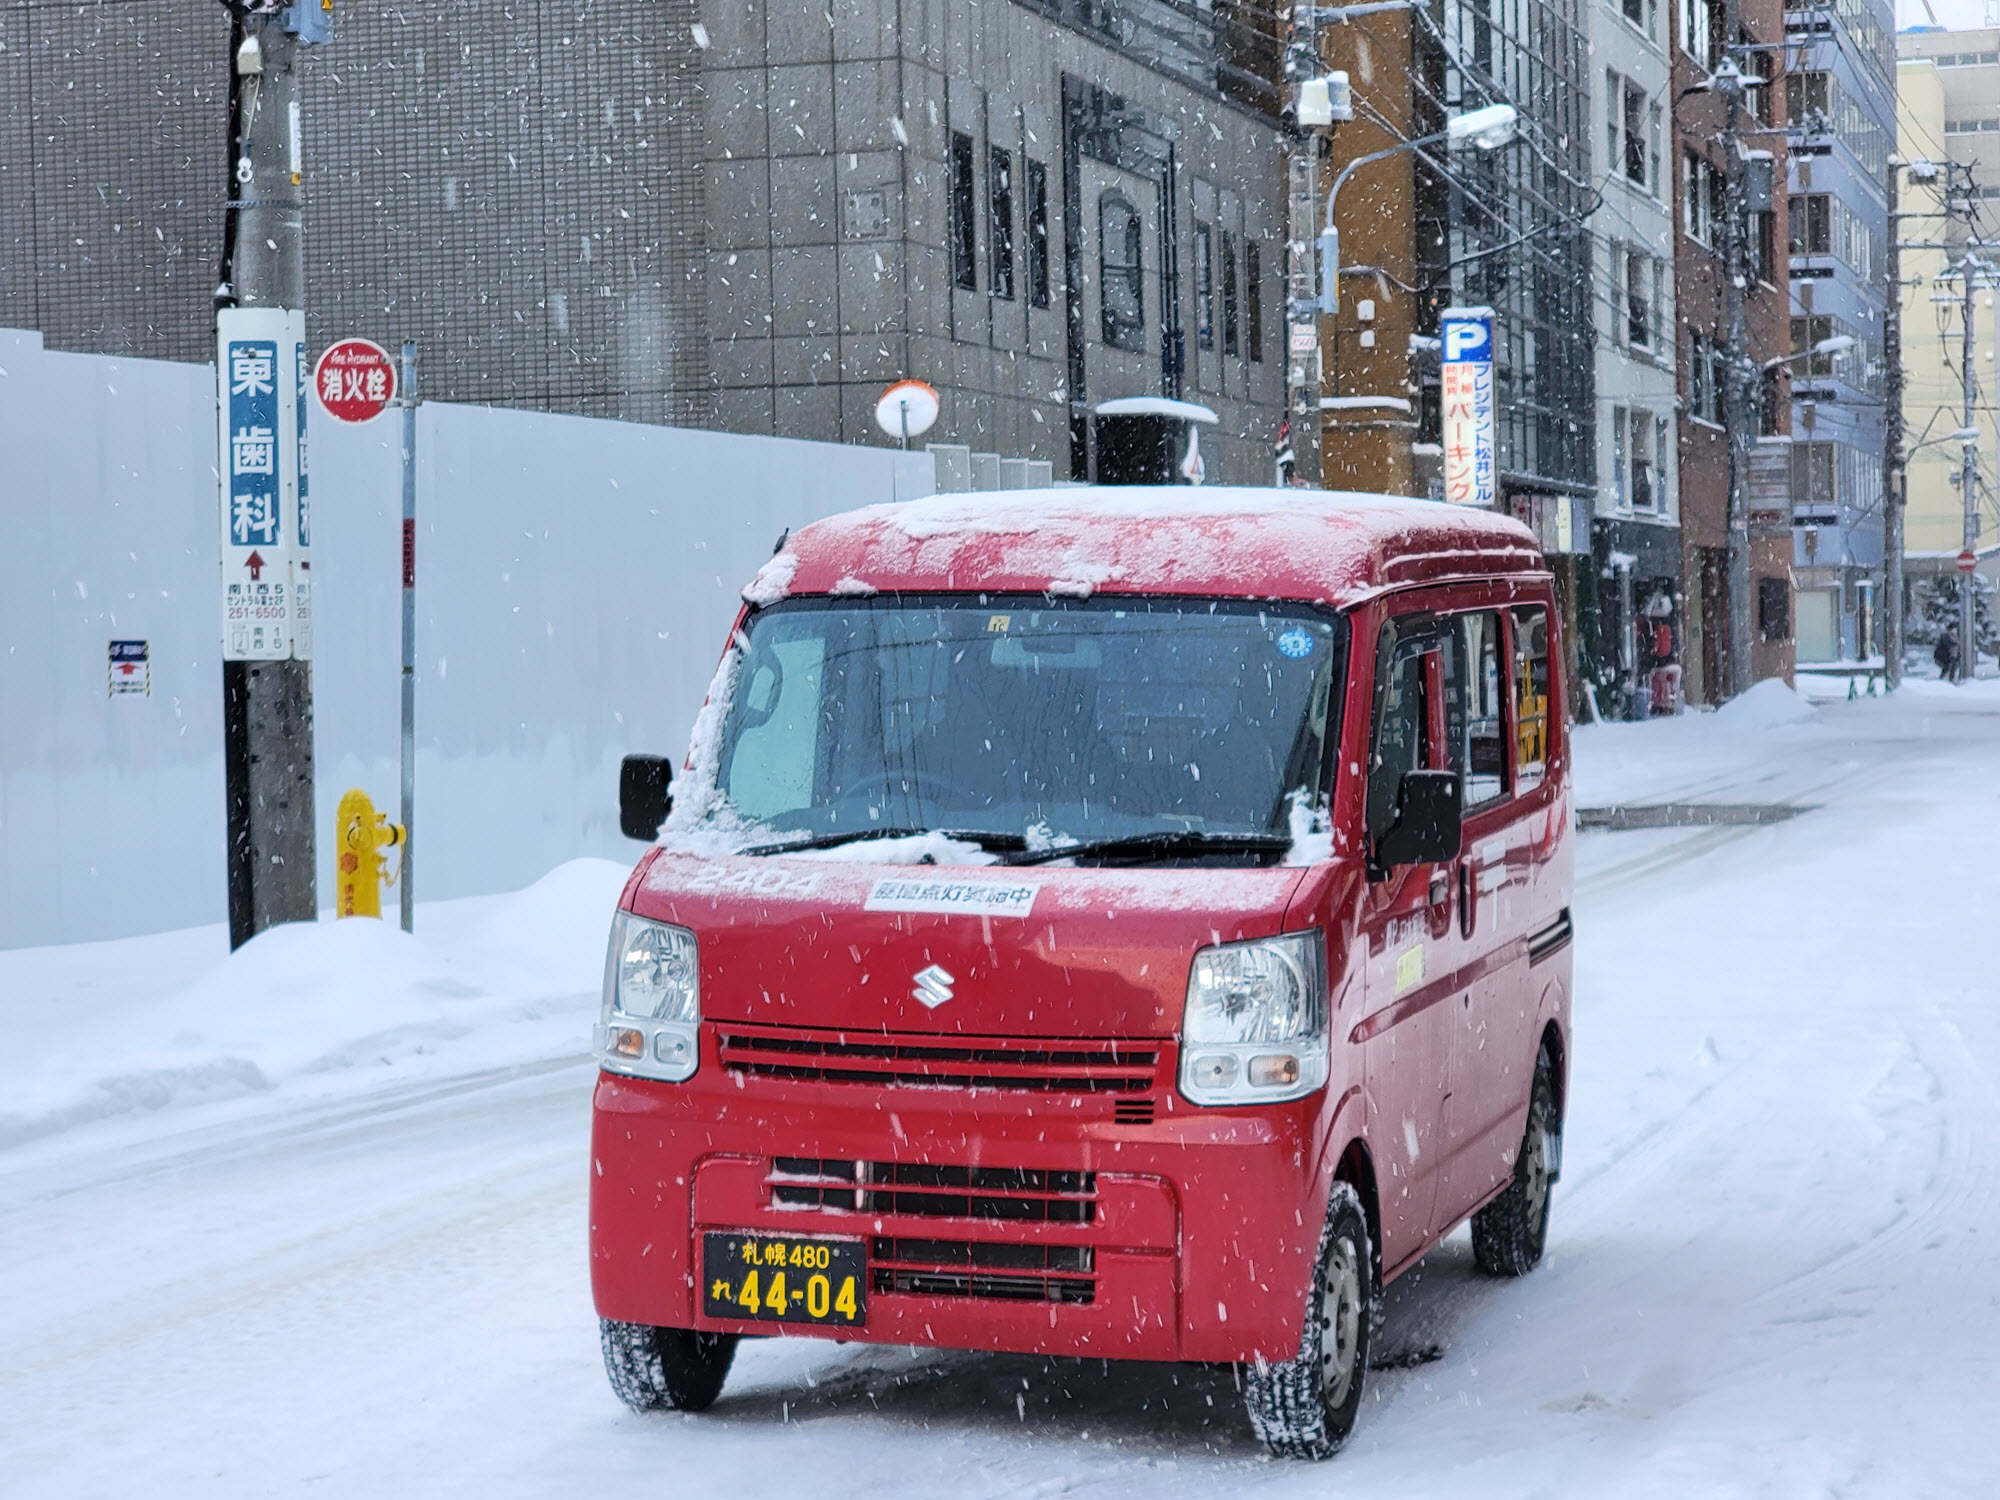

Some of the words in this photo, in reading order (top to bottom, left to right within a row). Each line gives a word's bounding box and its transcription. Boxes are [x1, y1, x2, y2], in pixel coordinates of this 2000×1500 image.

[1446, 322, 1488, 360] P
[323, 367, 386, 402] 消火栓
[231, 346, 275, 543] 東歯科
[1448, 403, 1471, 500] パーキング
[228, 607, 286, 619] 251-6500
[686, 866, 824, 895] 2404
[713, 1279, 731, 1300] れ
[738, 1270, 857, 1321] 44-04
